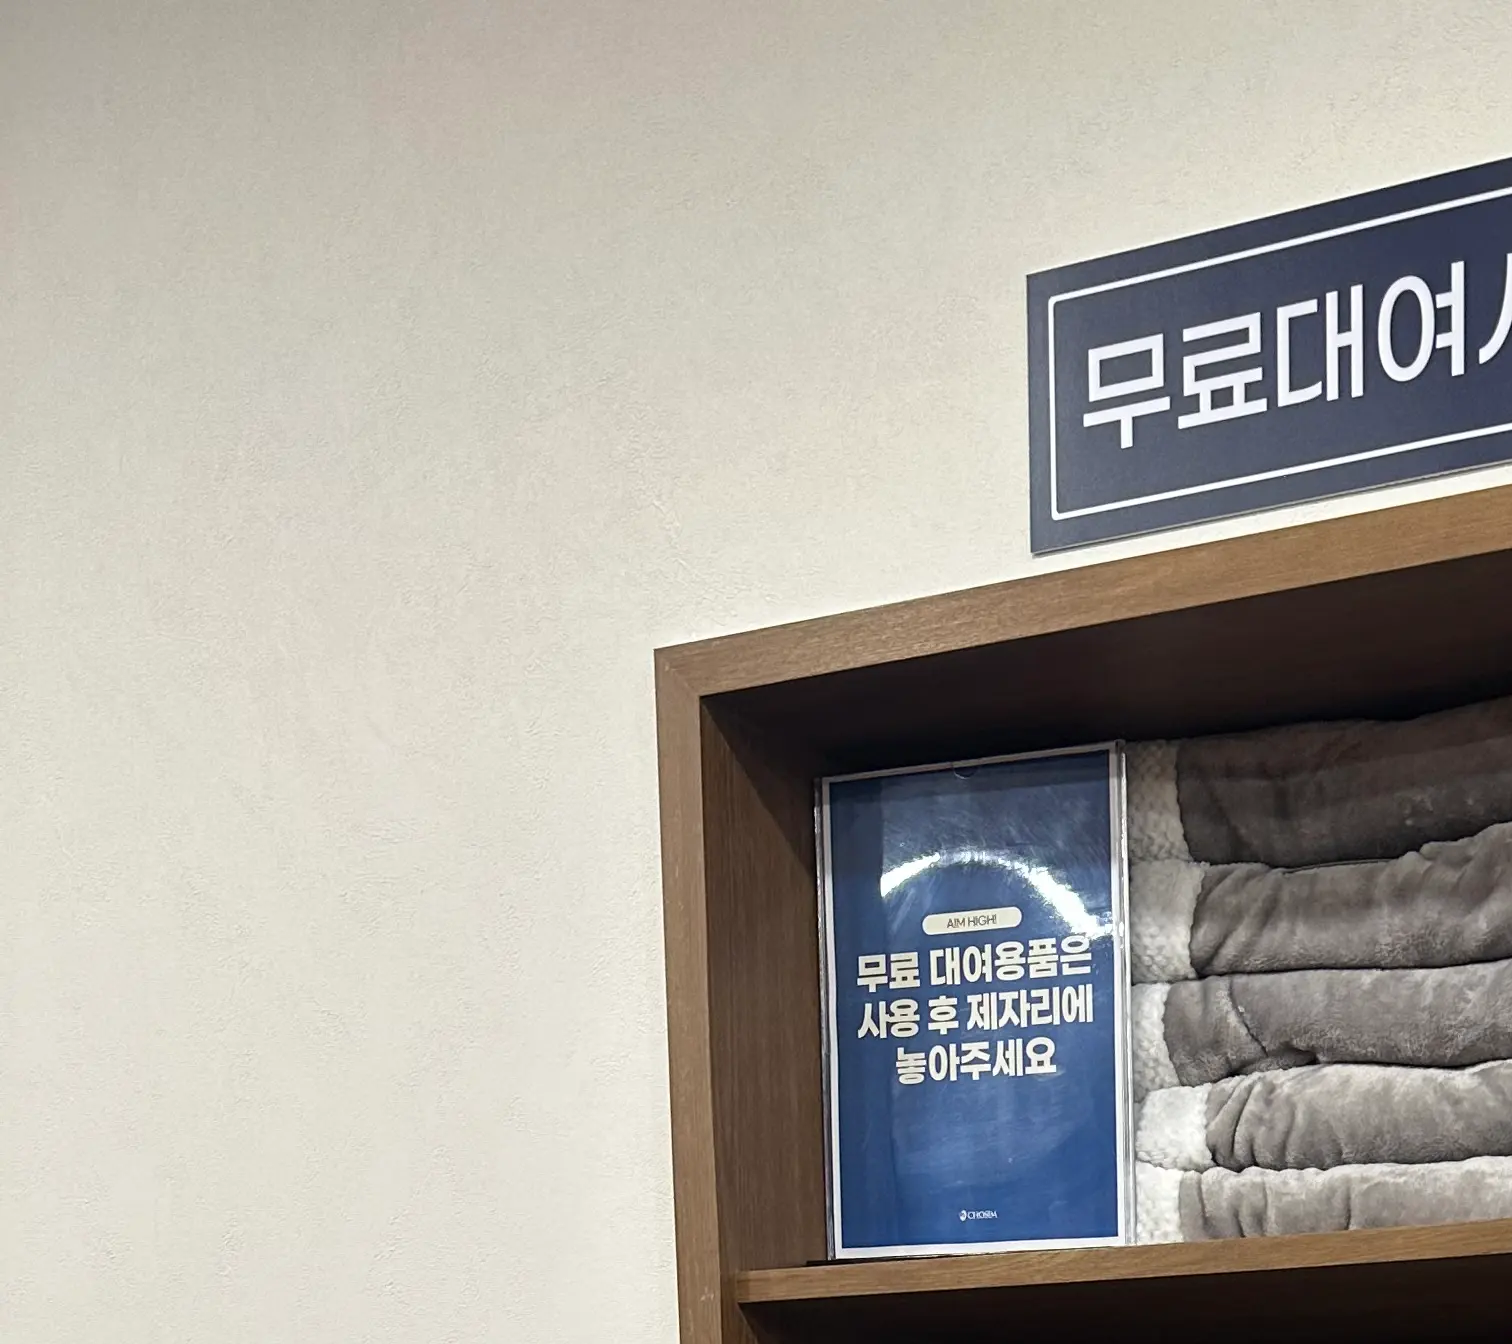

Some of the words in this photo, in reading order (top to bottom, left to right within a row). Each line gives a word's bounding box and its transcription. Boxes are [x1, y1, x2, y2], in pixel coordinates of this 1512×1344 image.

[947, 918, 965, 928] AIM
[857, 951, 921, 993] 무료
[929, 934, 1093, 987] 대여용품은
[857, 998, 920, 1039] 사용
[928, 997, 959, 1035] 후
[966, 984, 1094, 1031] 제자리에
[896, 1037, 1057, 1085] 놓아주세요
